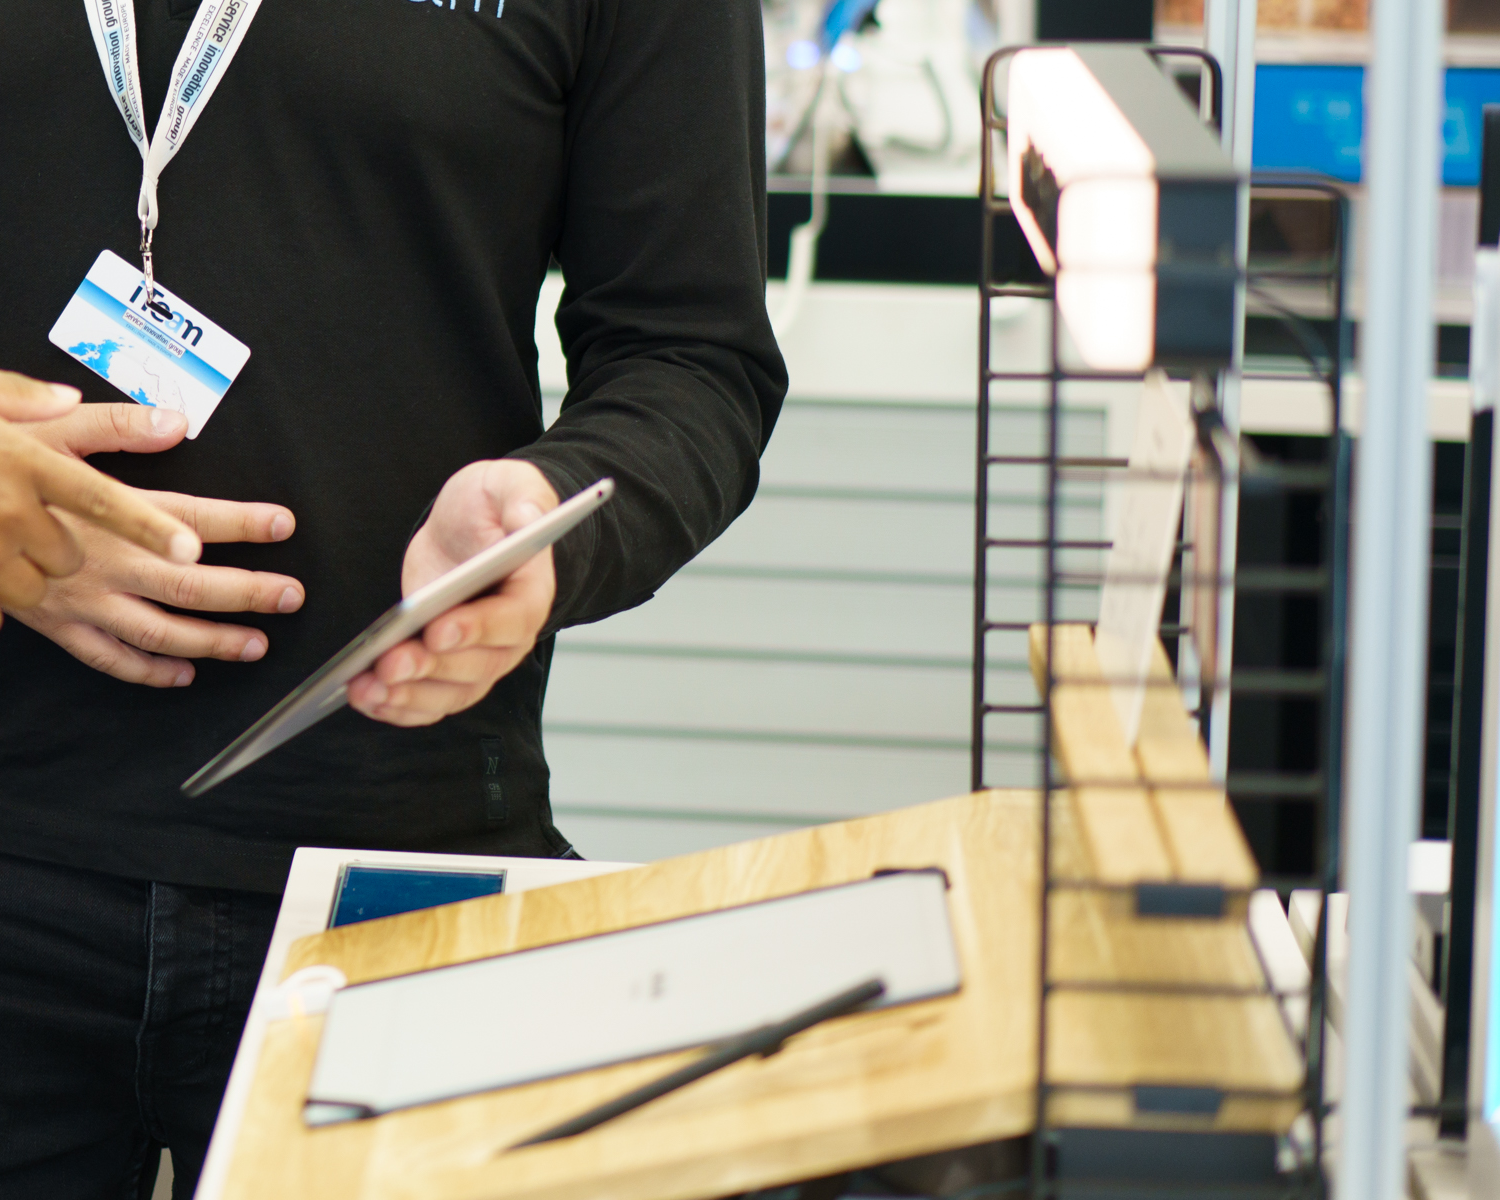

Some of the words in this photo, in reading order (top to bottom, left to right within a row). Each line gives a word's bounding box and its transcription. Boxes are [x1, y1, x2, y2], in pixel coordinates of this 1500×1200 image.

[120, 3, 129, 33] EUROPE
[125, 33, 129, 41] IN
[190, 4, 216, 52] EXCELLENCE
[212, 0, 241, 43] service
[109, 31, 124, 93] innovation
[175, 78, 181, 88] IN
[177, 57, 192, 79] MADE
[180, 44, 221, 103] innovation
[127, 70, 140, 119] EXCELLENCE
[167, 88, 178, 119] EUROPE
[121, 95, 141, 138] service
[170, 105, 185, 140] group
[125, 311, 144, 328] service
[143, 324, 169, 345] innovation
[168, 343, 183, 356] group
